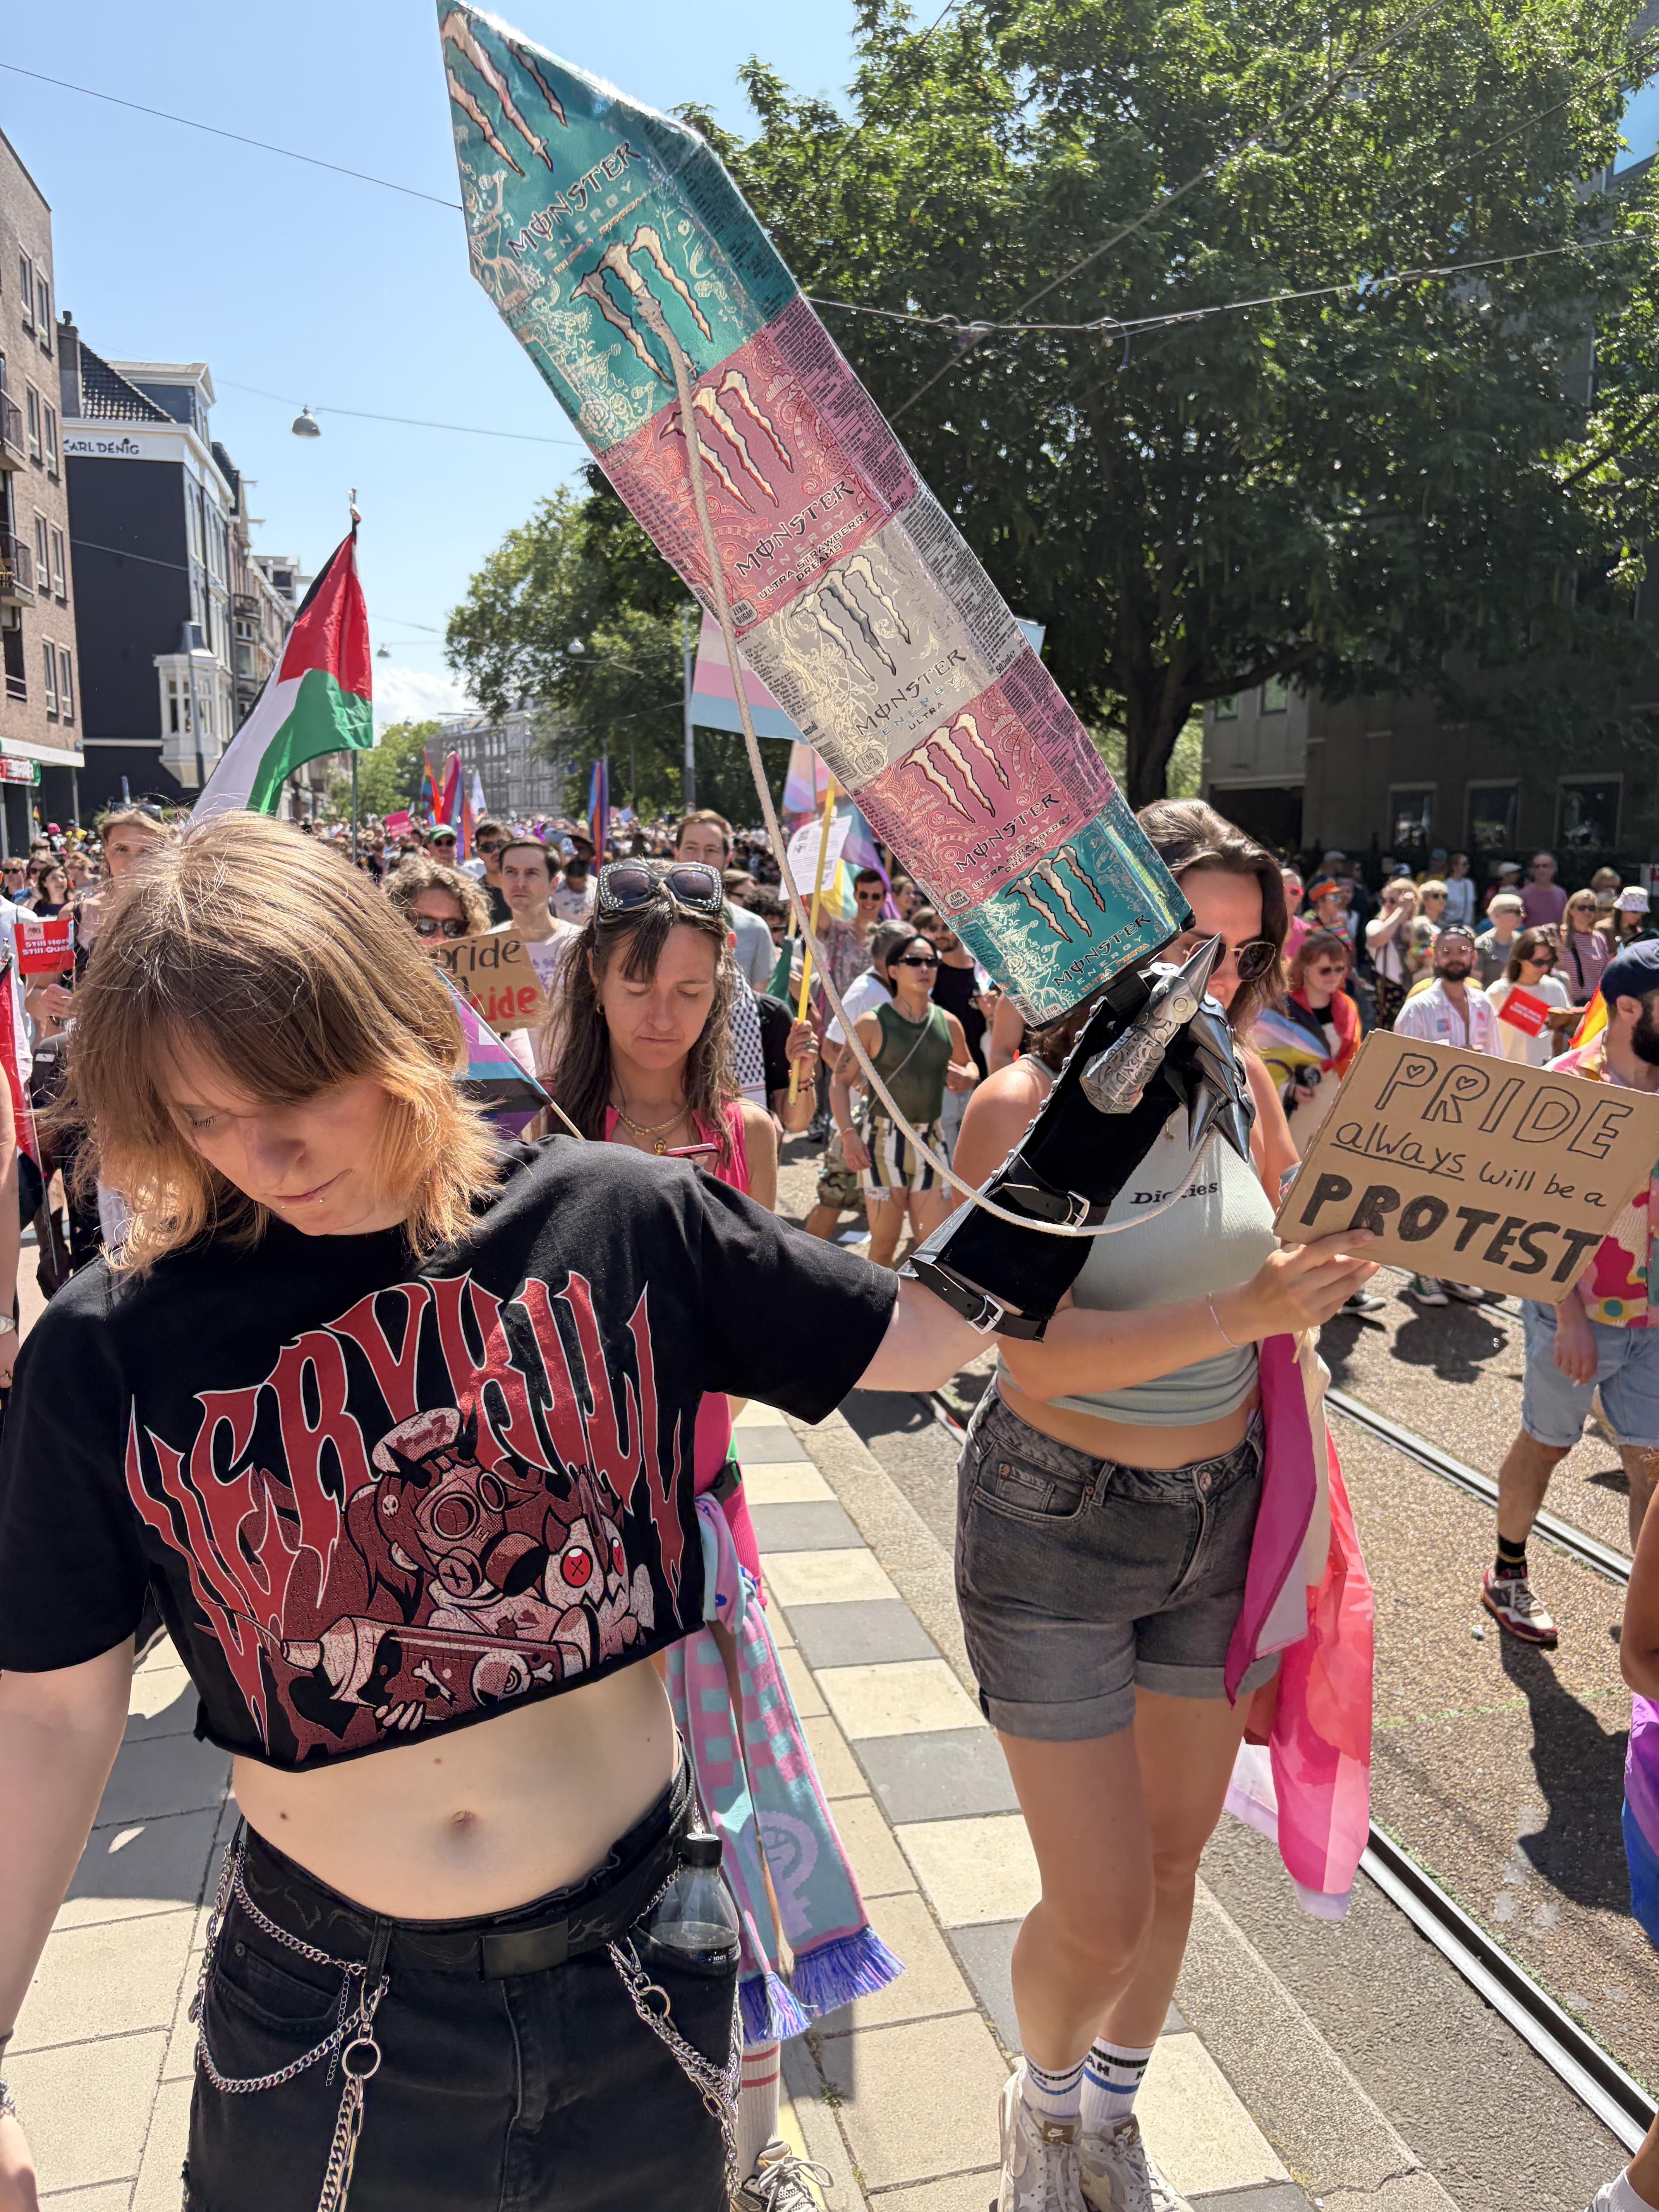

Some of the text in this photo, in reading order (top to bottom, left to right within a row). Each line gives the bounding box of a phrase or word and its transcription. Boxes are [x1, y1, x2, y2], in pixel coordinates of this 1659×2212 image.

[96, 438, 139, 455] DENIG
[735, 481, 855, 577] MONSTER
[758, 509, 870, 599] ULTRA STRAWBERRY
[795, 543, 842, 582] DREAMS
[732, 603, 747, 616] ZERO
[736, 609, 755, 624] SUGAR
[855, 649, 967, 735] MONSTER
[909, 702, 945, 731] ULTRA
[955, 794, 1060, 872] MONSTER
[972, 813, 1070, 890] ULTRA STRAWBERRY
[1005, 841, 1046, 873] DREAMS
[950, 891, 962, 902] ZERO
[951, 896, 968, 908] SUGAR
[1374, 1053, 1633, 1159] PRIDE
[1335, 1122, 1607, 1207] always will be a
[1299, 1173, 1604, 1283] PROTEST
